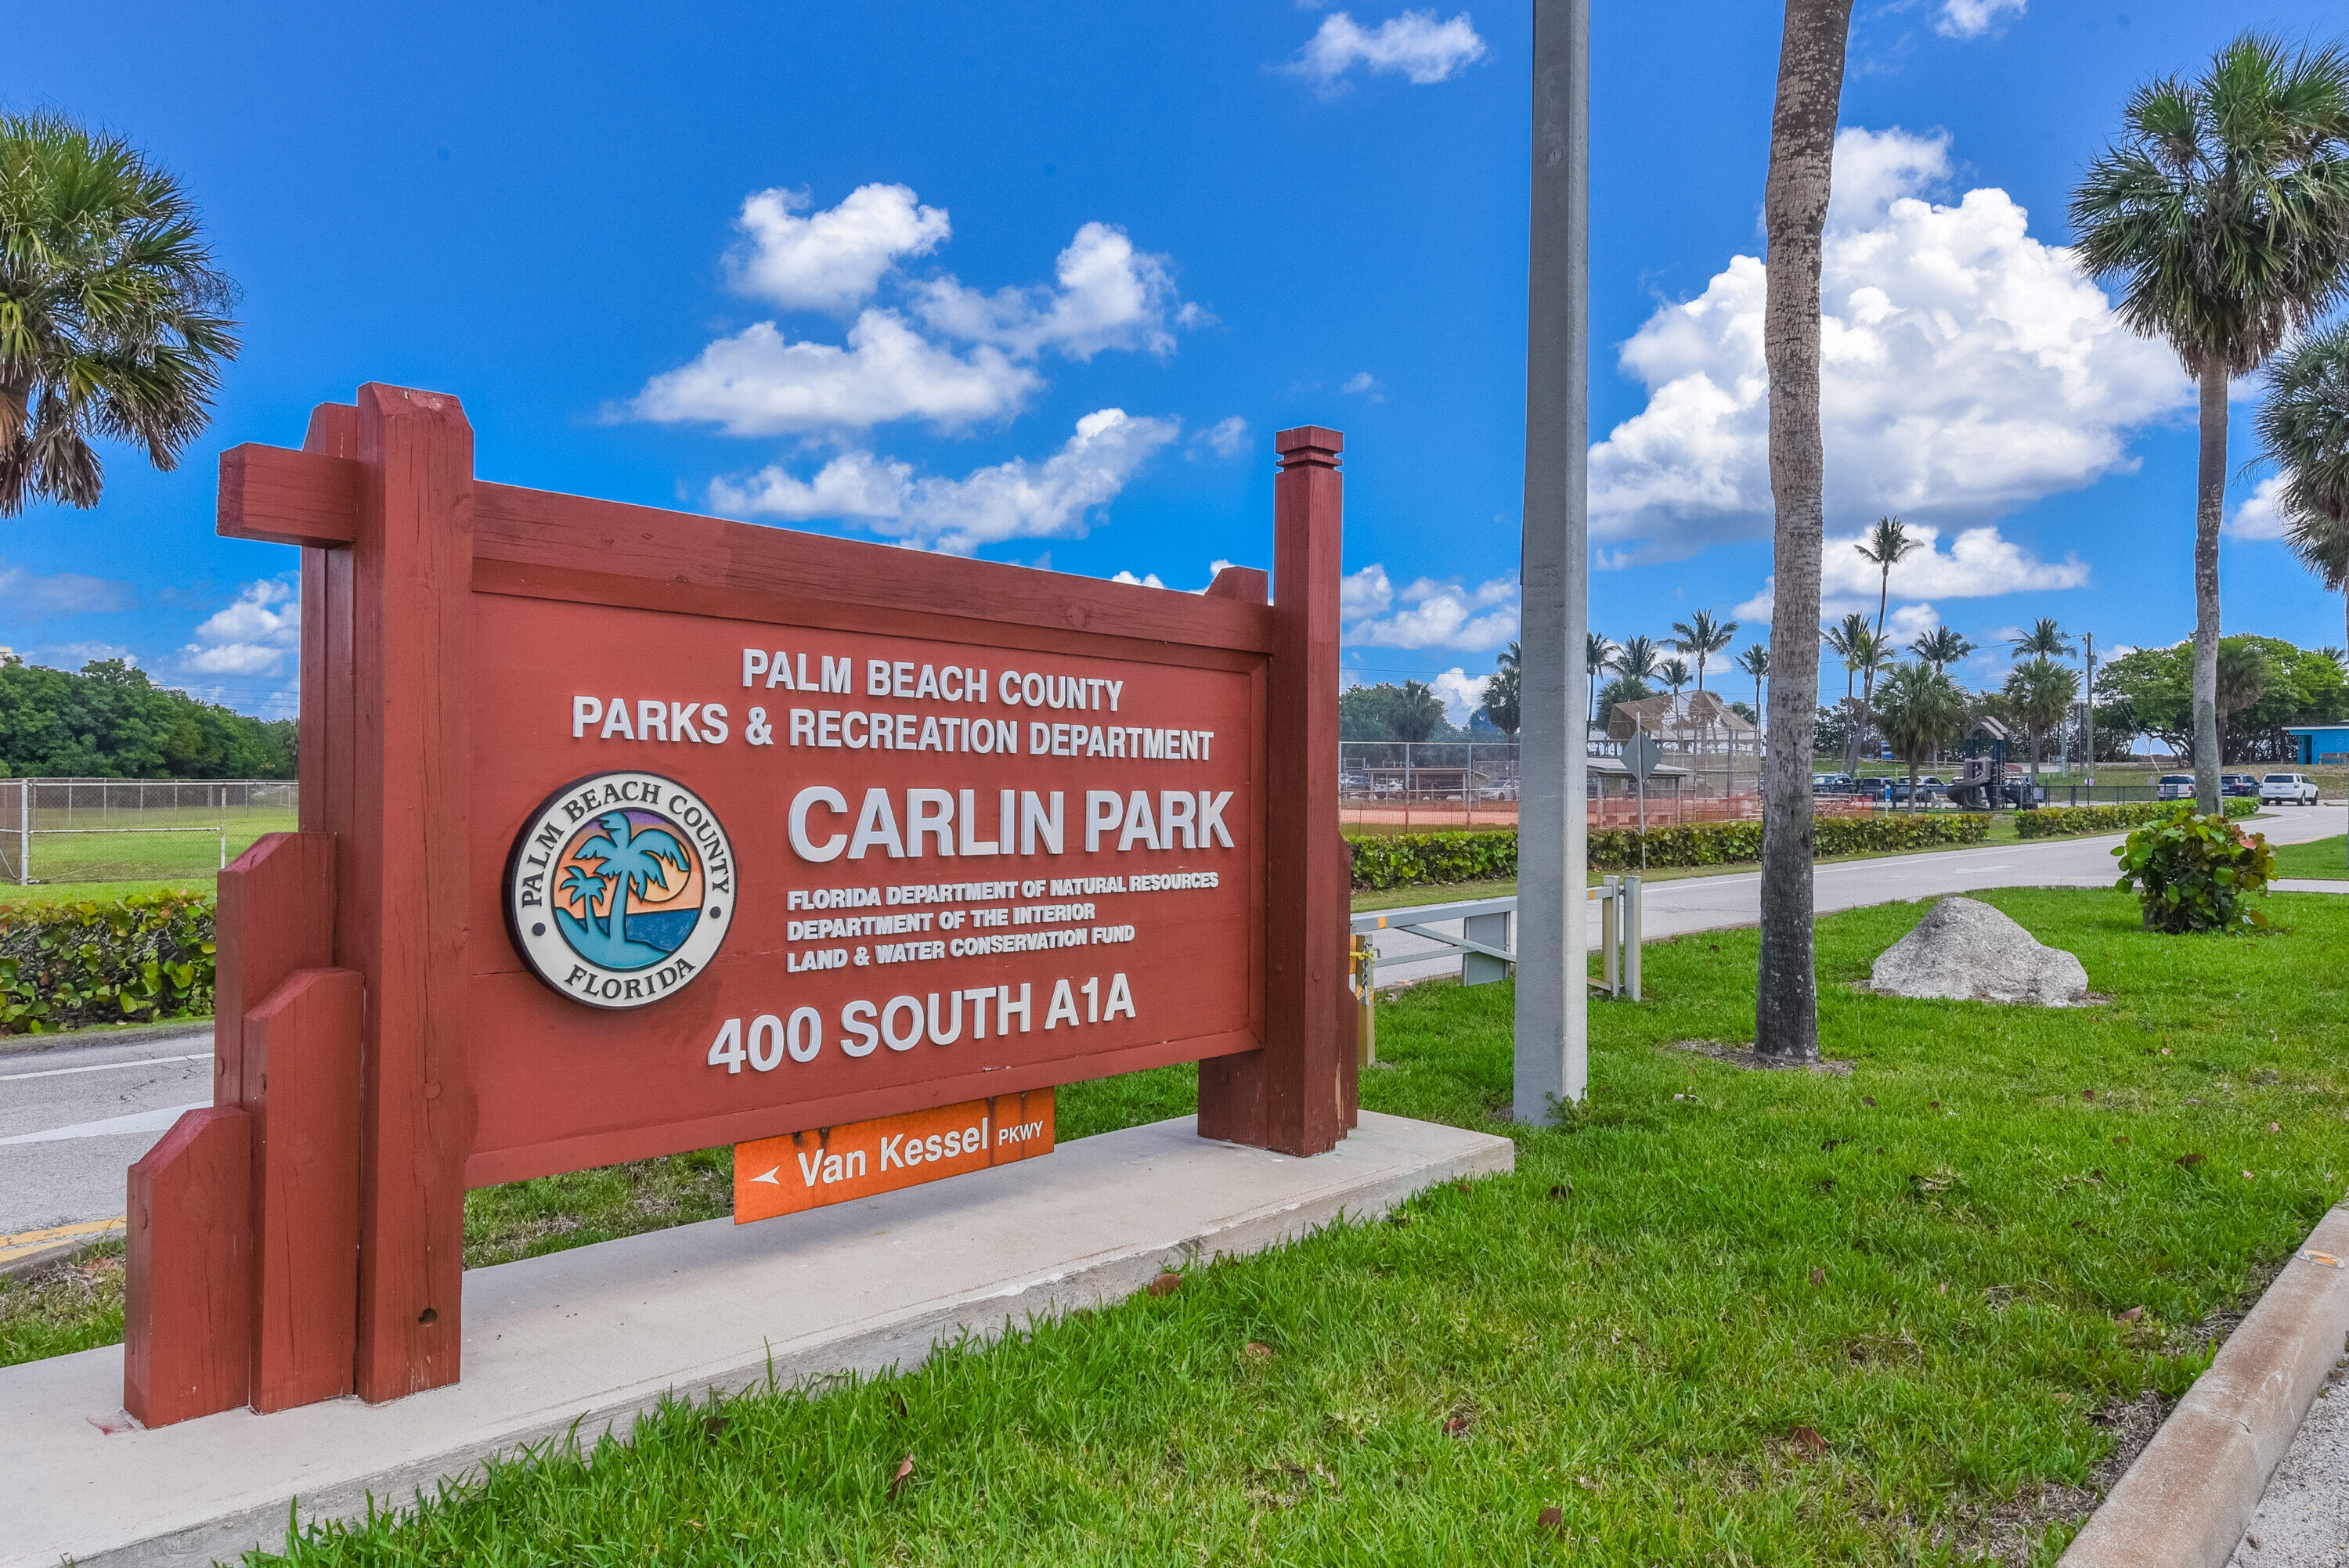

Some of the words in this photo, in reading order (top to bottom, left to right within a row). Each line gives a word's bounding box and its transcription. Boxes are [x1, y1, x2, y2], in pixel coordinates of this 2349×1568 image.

[742, 648, 852, 694] PALM
[867, 659, 987, 703] BEACH
[998, 670, 1124, 712] COUNTY
[572, 695, 729, 744] PARKS
[745, 706, 774, 745] &
[789, 708, 1018, 754] RECREATION
[1029, 722, 1214, 761] DEPARTMENT
[522, 821, 565, 908] PALM
[561, 781, 662, 824] BEACH
[669, 795, 730, 894] COUNTY
[788, 785, 1064, 862] CARLIN
[1085, 790, 1235, 852] PARK
[787, 886, 882, 910] FLORIDA
[886, 881, 1018, 906] DEPARTMENT
[1021, 879, 1046, 898] OF
[1049, 876, 1127, 896] NATURAL
[1129, 871, 1219, 892] RESOURCES
[787, 913, 934, 941] DEPARTMENT
[938, 910, 965, 930] OF
[969, 908, 1009, 927] THE
[1012, 903, 1095, 925] INTERIOR
[565, 957, 696, 1000] FLORIDA
[787, 948, 849, 972] LAND
[853, 946, 871, 966] &
[875, 941, 945, 964] WATER
[949, 928, 1088, 957] CONSERVATION
[1091, 925, 1135, 944] FUND
[707, 1006, 822, 1074] 400
[840, 982, 1031, 1058] SOUTH
[1045, 973, 1136, 1030] A1A
[797, 1148, 866, 1187] Van
[880, 1117, 988, 1172] Kessel
[998, 1120, 1044, 1146] PKWY
